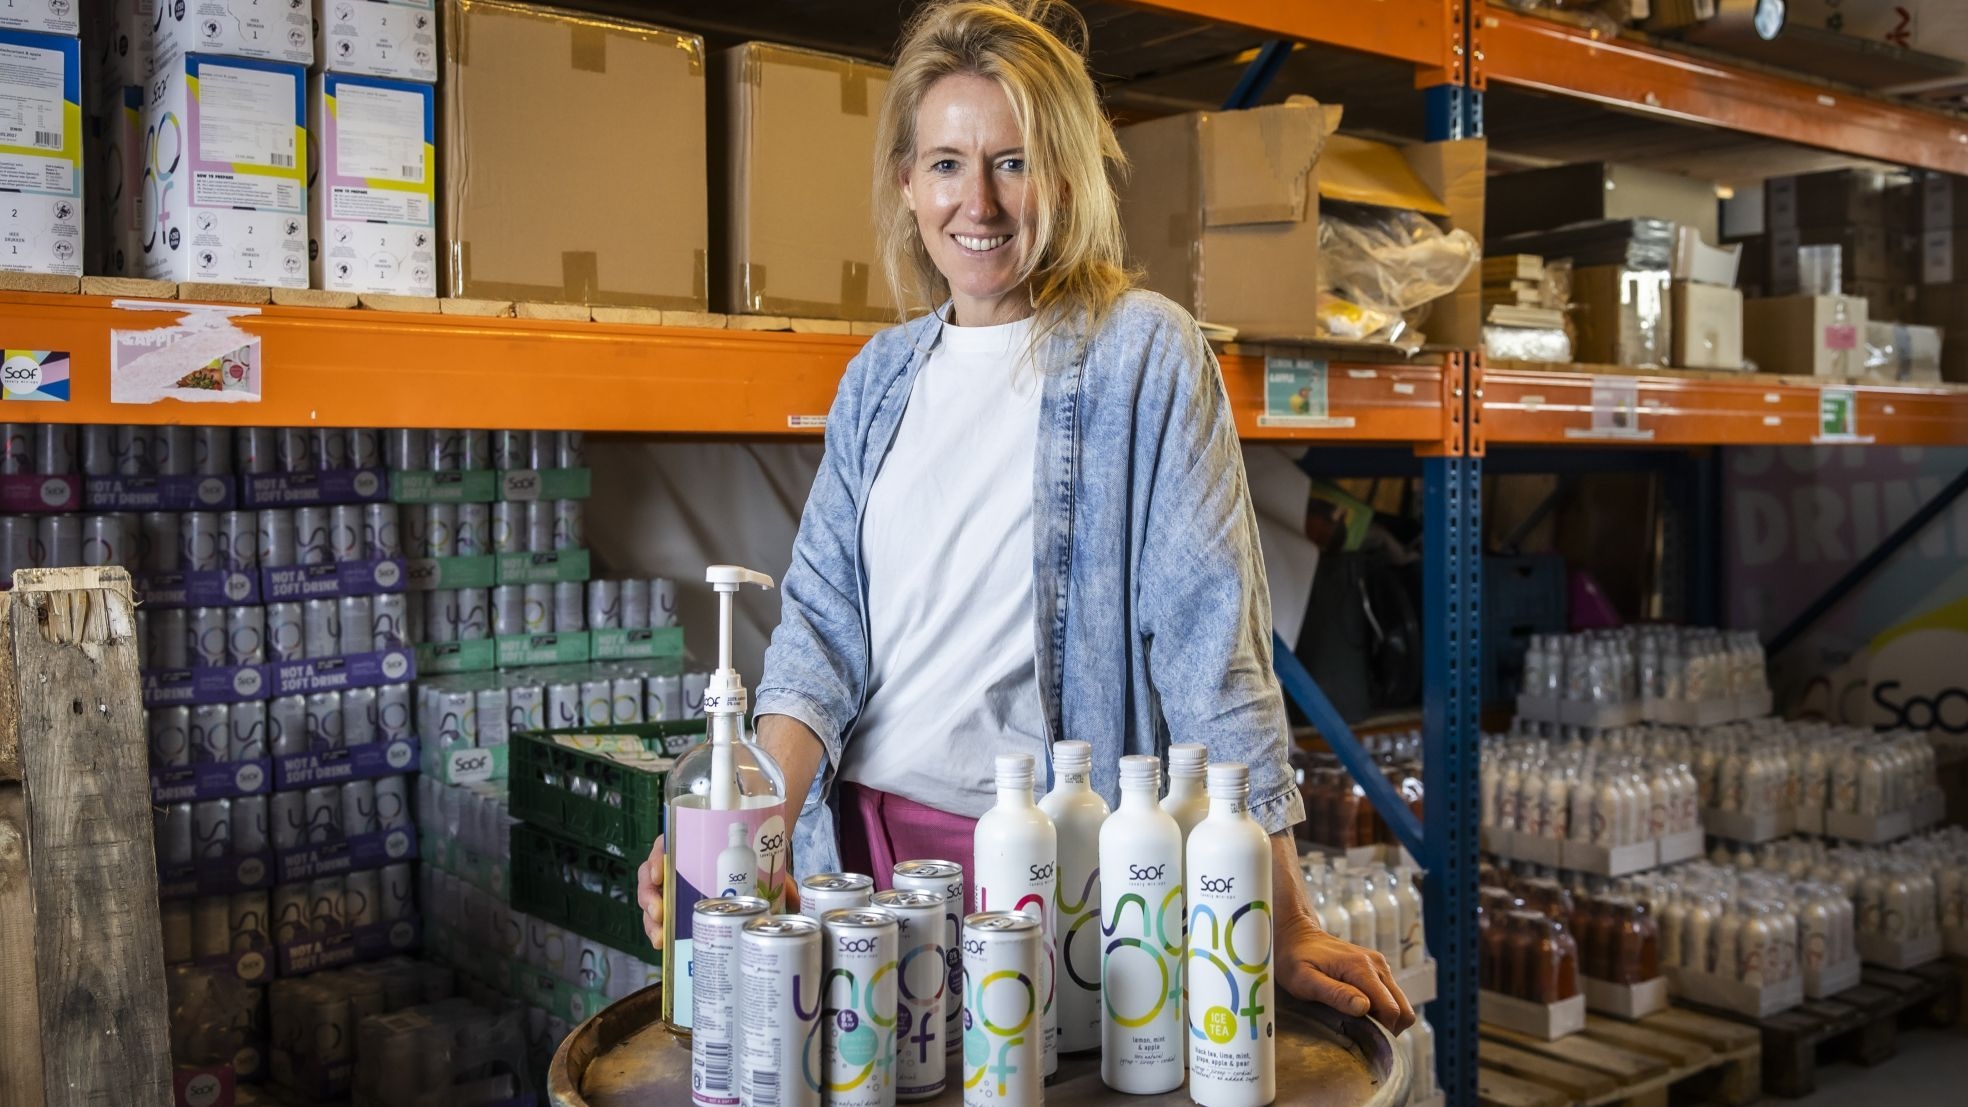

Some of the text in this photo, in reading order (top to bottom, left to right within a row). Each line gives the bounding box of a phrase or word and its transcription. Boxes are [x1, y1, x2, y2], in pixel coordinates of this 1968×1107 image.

[12, 208, 18, 217] 2
[248, 226, 254, 235] 2
[380, 238, 386, 246] 2
[12, 245, 18, 254] 1
[248, 260, 253, 268] 1
[1733, 476, 1968, 566] DRIN
[270, 569, 305, 584] NOT A
[271, 580, 337, 597] SOFT DRINK
[280, 664, 314, 679] NOT A
[281, 673, 347, 692] SOFT DRINK
[1129, 863, 1166, 880] SoOf
[1200, 875, 1235, 893] SoOf
[838, 936, 879, 952] SoOf
[1210, 1011, 1227, 1024] ICE
[1209, 1023, 1230, 1037] TEA
[1144, 1043, 1160, 1051] apple
[1211, 1057, 1228, 1066] apple
[1235, 1060, 1251, 1069] pear
